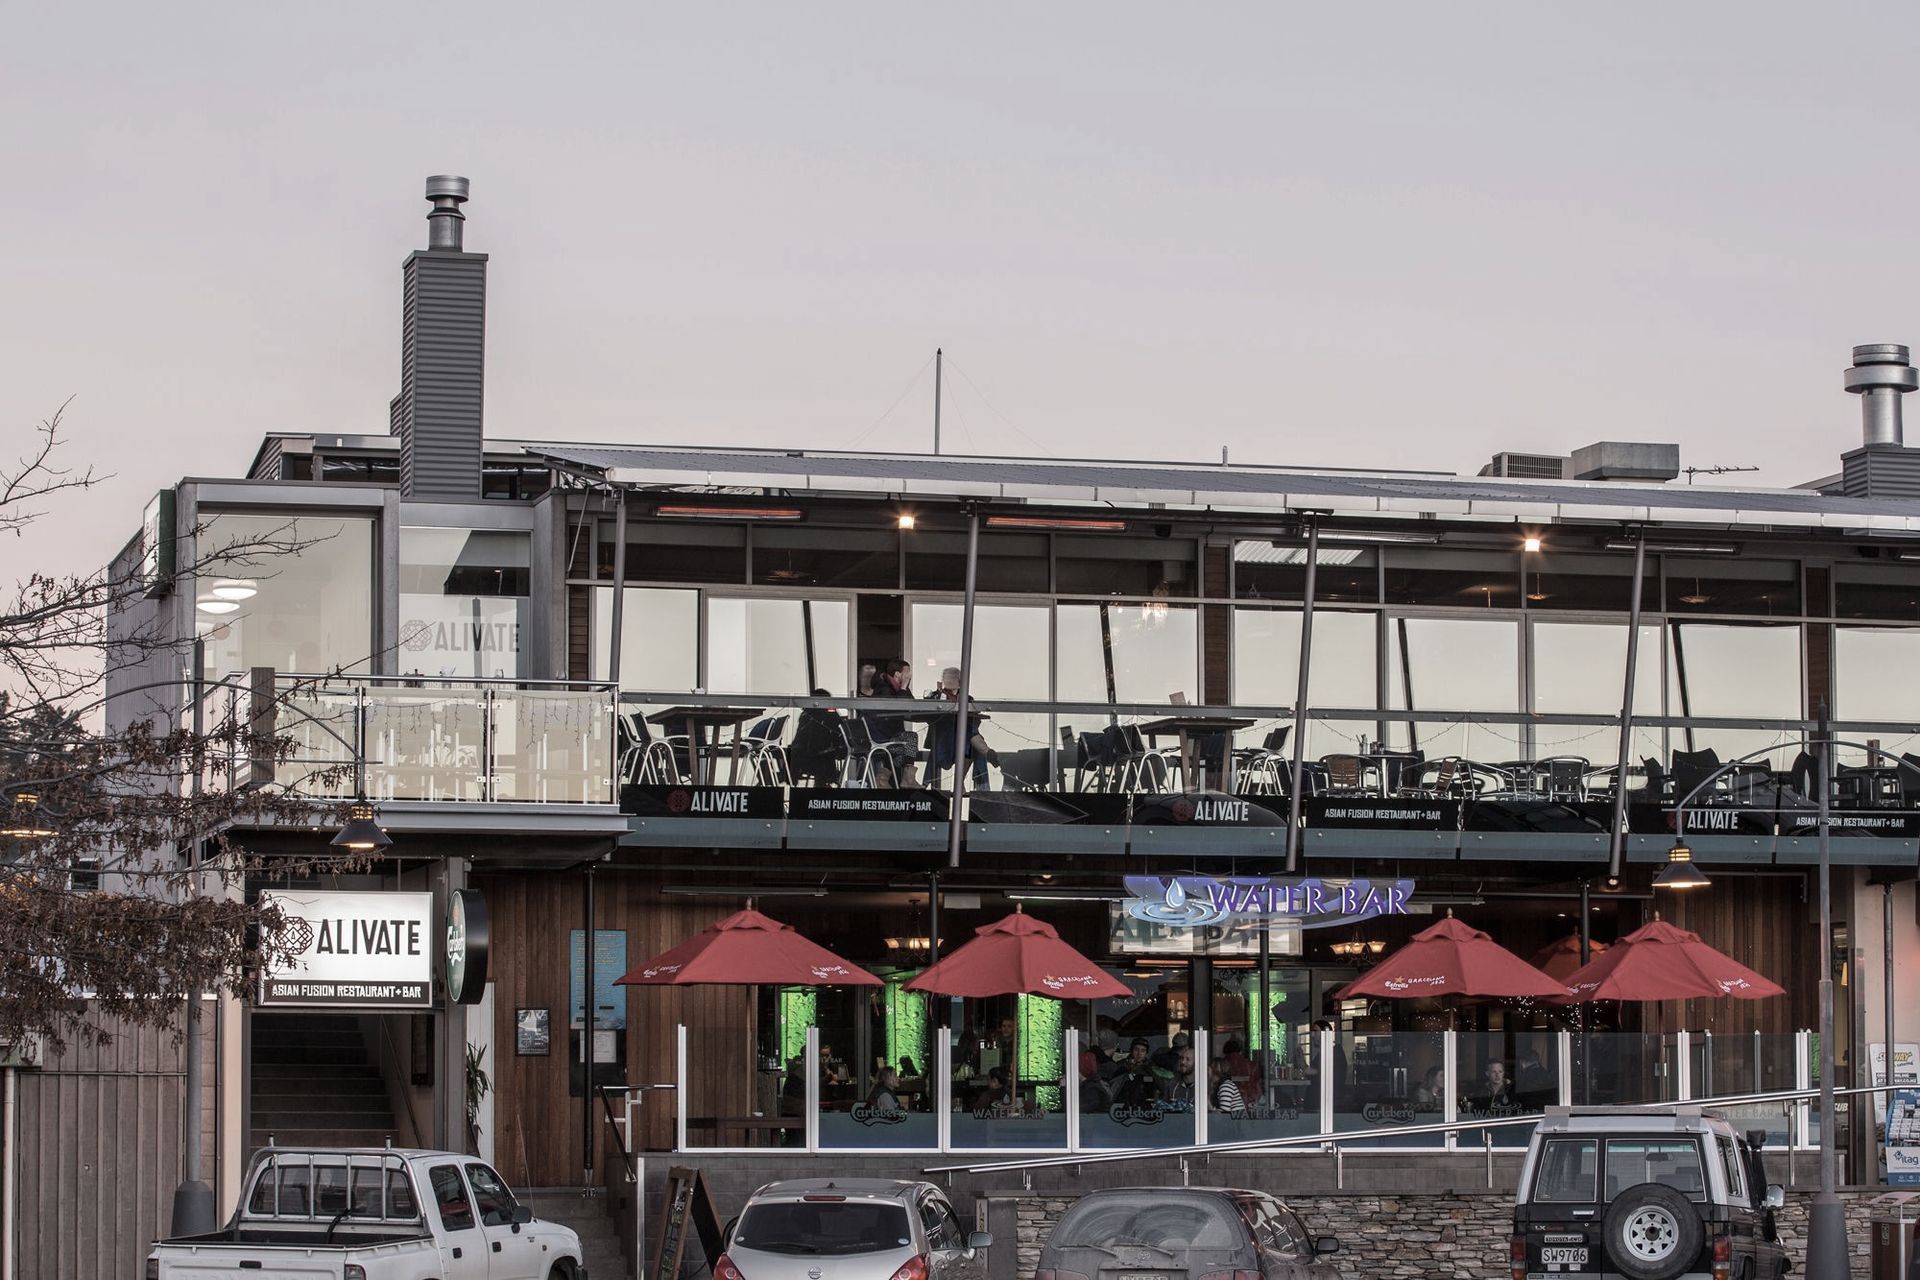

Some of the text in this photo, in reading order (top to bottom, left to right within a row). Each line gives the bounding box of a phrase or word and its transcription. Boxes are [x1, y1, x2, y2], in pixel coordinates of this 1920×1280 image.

[434, 622, 520, 652] ALIVATE
[691, 791, 749, 813] ALIVATE
[808, 800, 831, 809] ASIAN
[833, 800, 860, 810] FUSION
[1194, 801, 1250, 822] ALIVATE
[1325, 809, 1346, 818] ASIAN
[1348, 809, 1374, 819] FUSION
[1687, 811, 1738, 830] ALIVATE
[1796, 817, 1817, 826] ASIAN
[1206, 884, 1410, 915] WATER BAR
[316, 918, 421, 955] ALIVATE
[272, 985, 300, 997] ASIAN
[301, 985, 335, 997] FUSION
[851, 1102, 907, 1123] Carlsberg
[1109, 1103, 1164, 1124] Carlsberg
[1231, 1109, 1297, 1119] WATER BAR
[1363, 1103, 1416, 1123] Carlsberg
[1753, 1108, 1775, 1118] BAR
[1543, 1249, 1587, 1262] SW9706
